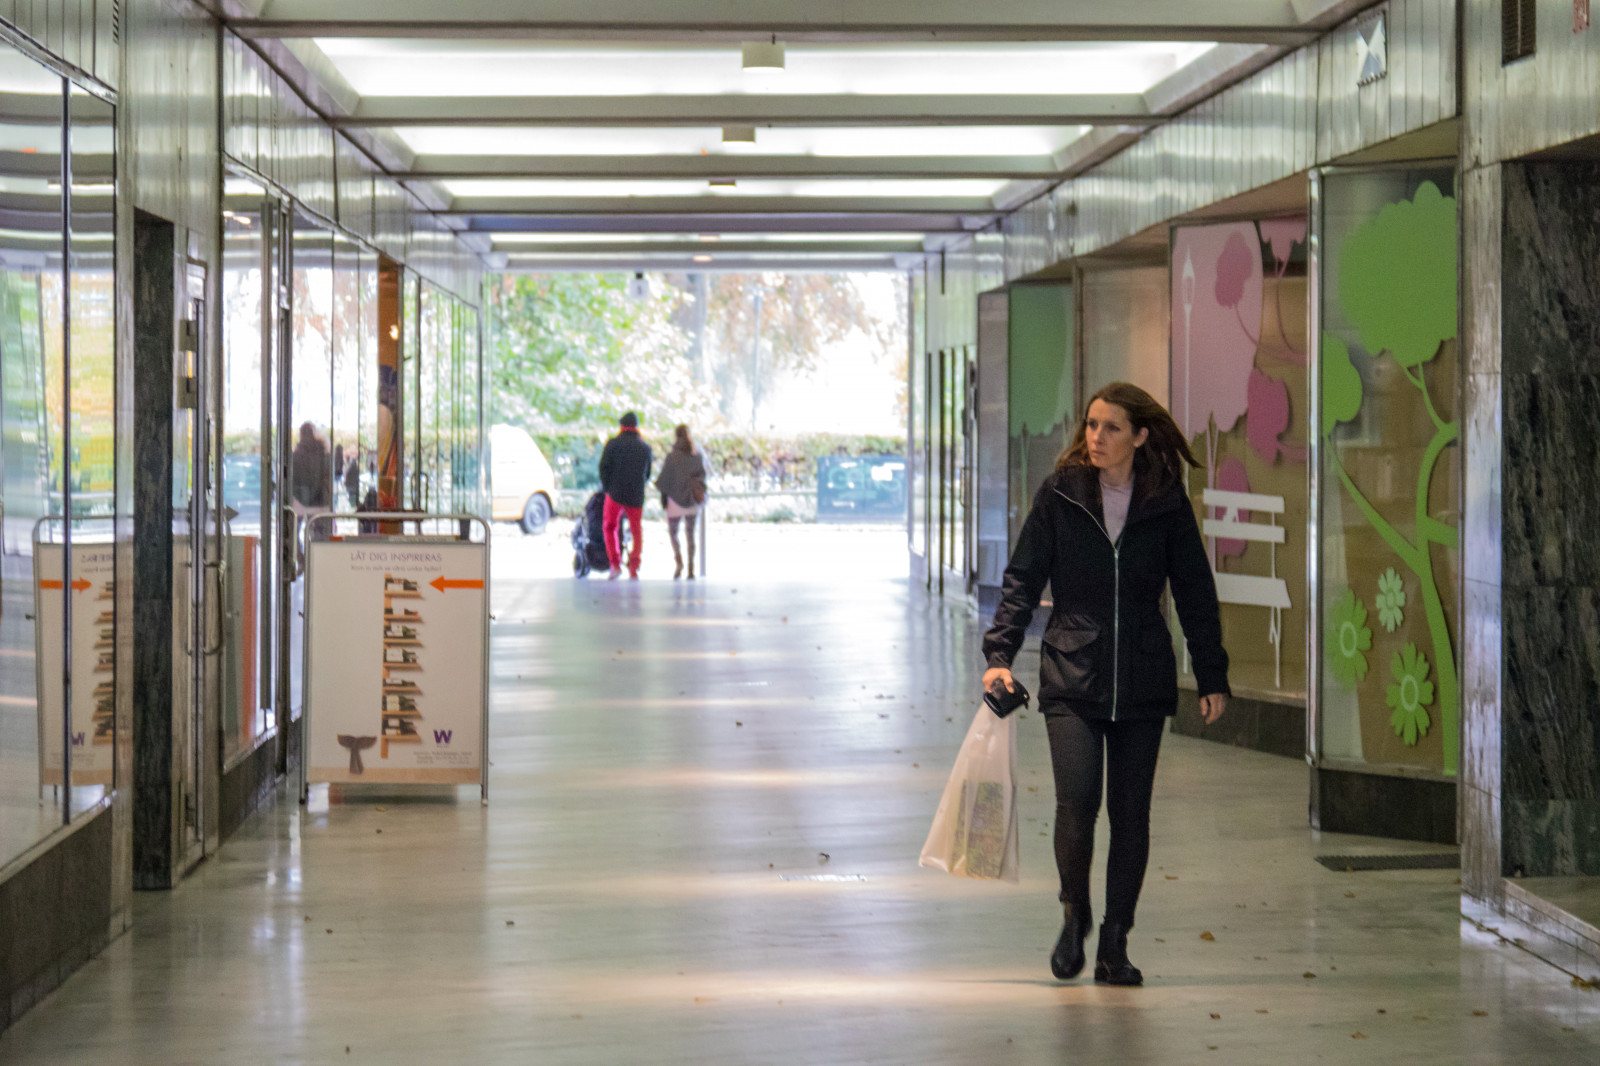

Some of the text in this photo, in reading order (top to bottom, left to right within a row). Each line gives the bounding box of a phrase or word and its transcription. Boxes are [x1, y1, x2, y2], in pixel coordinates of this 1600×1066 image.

[350, 550, 442, 562] LÅT DIG INSPIRERAS
[433, 729, 452, 744] W
